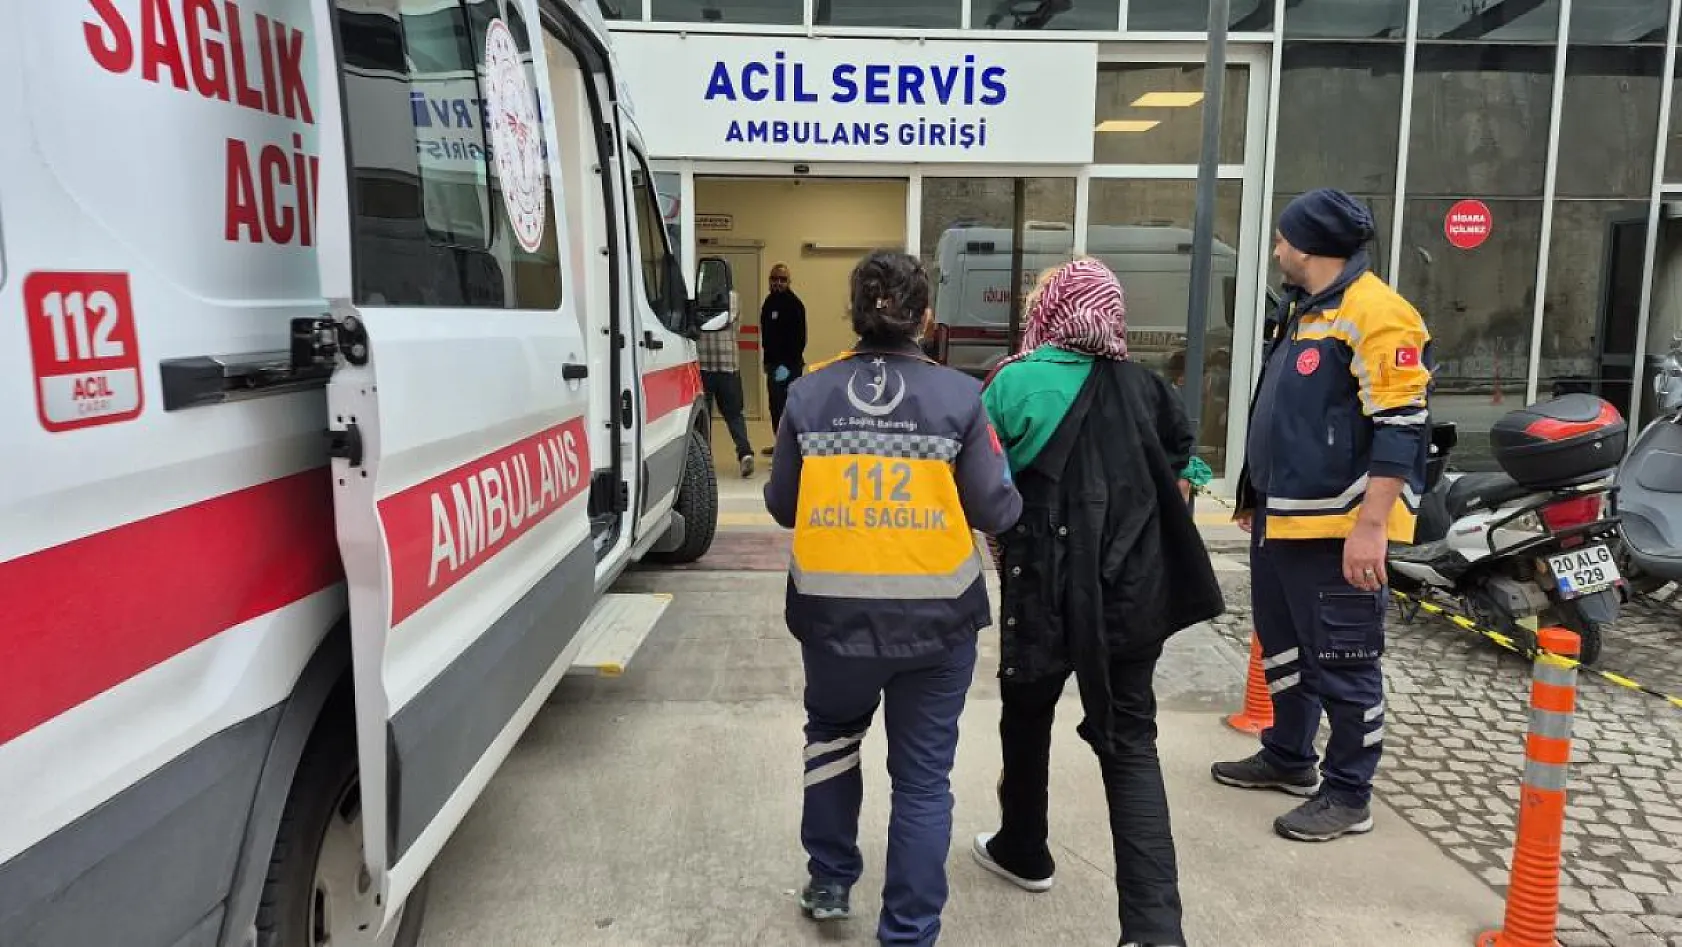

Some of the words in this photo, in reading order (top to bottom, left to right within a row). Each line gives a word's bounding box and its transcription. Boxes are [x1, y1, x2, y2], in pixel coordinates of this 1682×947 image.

[704, 51, 818, 102] ACİL
[831, 54, 1007, 105] SERVİS
[725, 120, 890, 145] AMBULANS
[899, 117, 987, 149] GİRİŞİ
[1450, 224, 1487, 236] İÇİLMEZ
[1451, 212, 1486, 223] SİGARA
[42, 290, 125, 361] 112
[843, 460, 911, 501] 112
[427, 430, 580, 588] AMBULANS
[809, 501, 857, 527] ACİL
[863, 502, 947, 530] SAĞLIK
[1553, 557, 1573, 574] 20
[1576, 547, 1609, 570] ALG
[1573, 567, 1604, 586] 529
